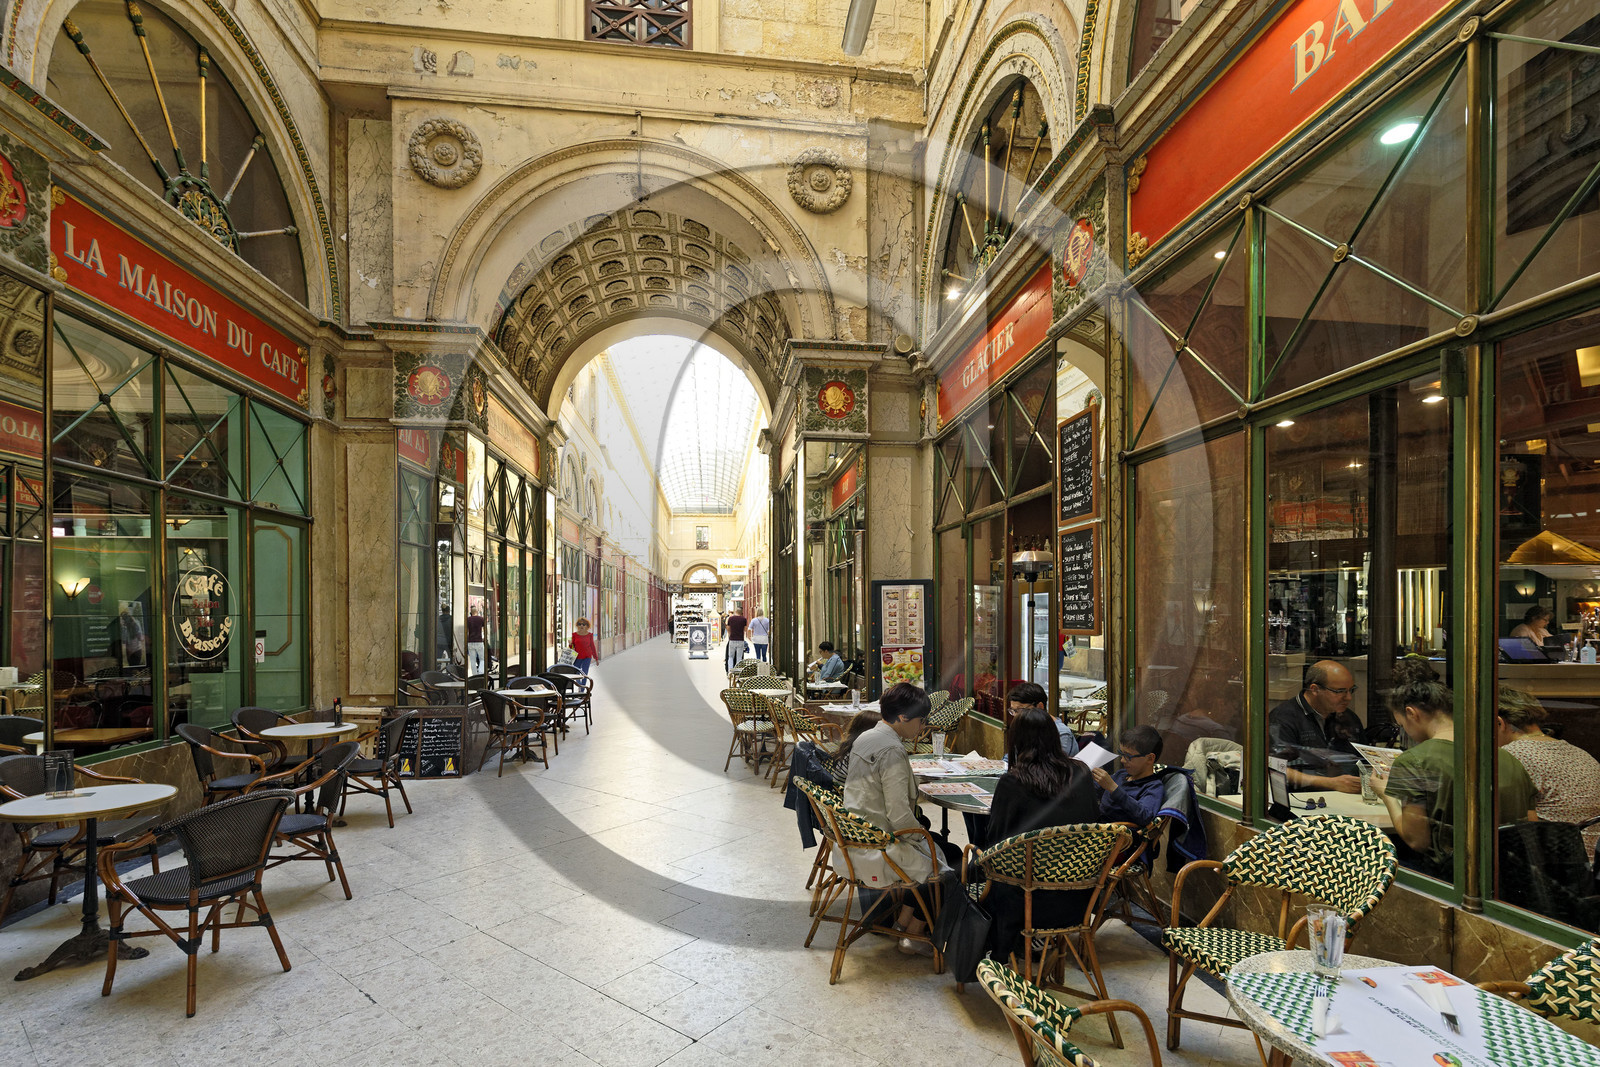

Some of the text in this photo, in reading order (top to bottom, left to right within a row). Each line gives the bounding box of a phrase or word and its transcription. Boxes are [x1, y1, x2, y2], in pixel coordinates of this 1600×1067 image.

[1290, 0, 1394, 94] BA
[63, 220, 299, 385] LA MAISON DU CAFE
[962, 321, 1015, 389] GLACIER
[185, 574, 223, 597] Café
[193, 599, 220, 609] Salon
[180, 616, 234, 652] Brasserie
